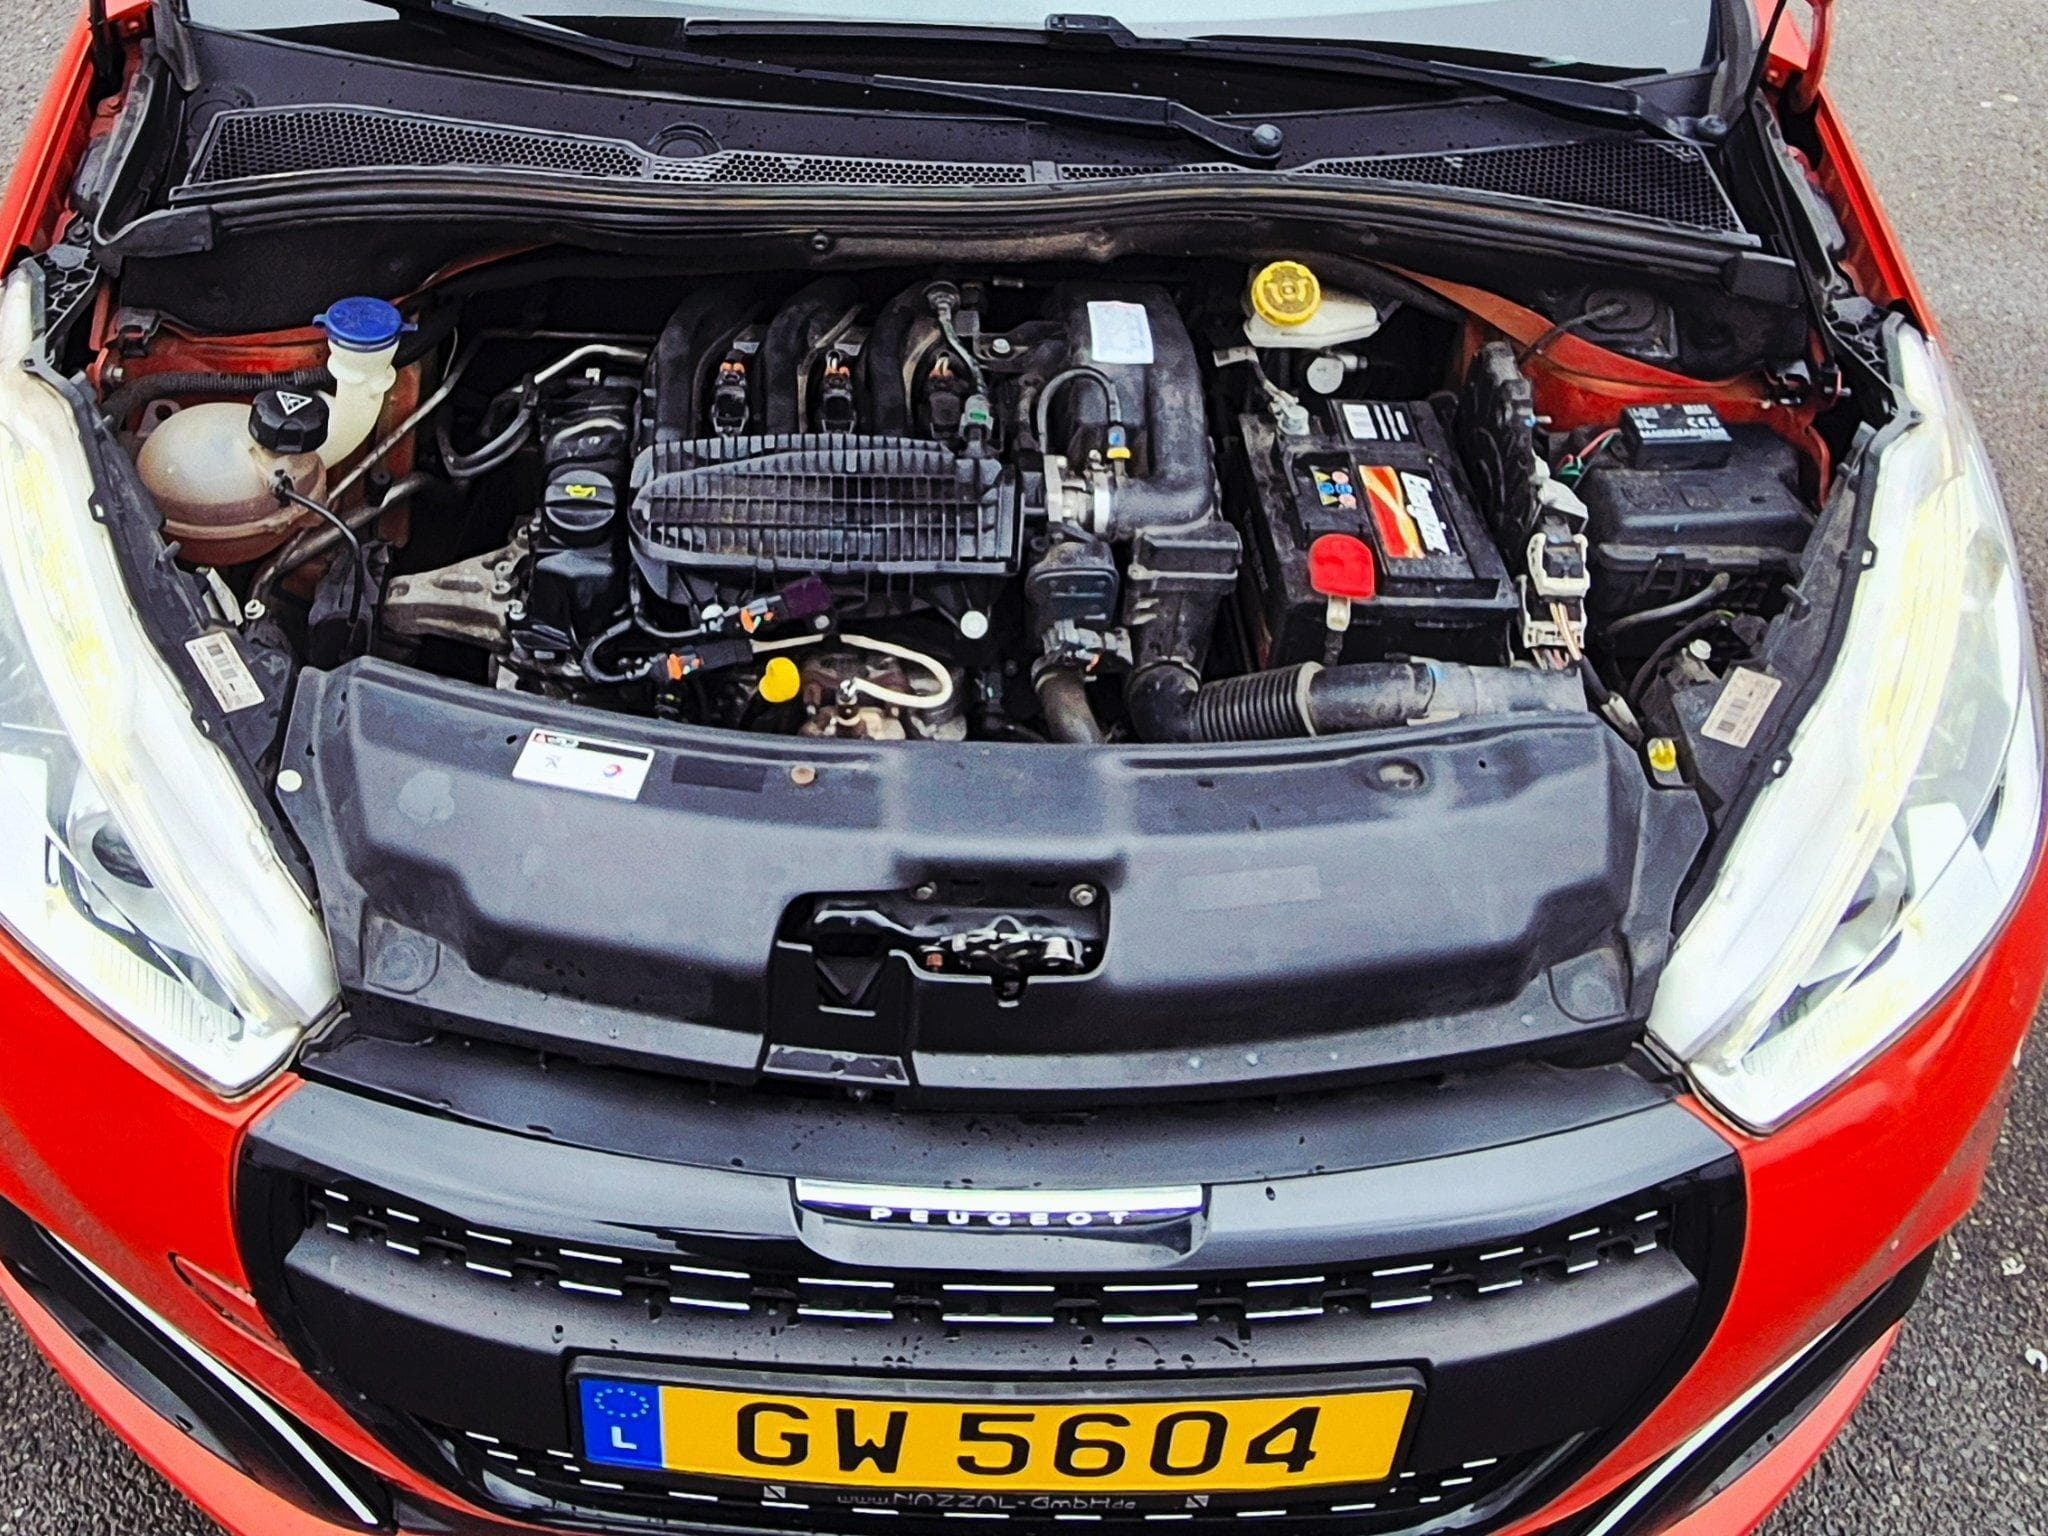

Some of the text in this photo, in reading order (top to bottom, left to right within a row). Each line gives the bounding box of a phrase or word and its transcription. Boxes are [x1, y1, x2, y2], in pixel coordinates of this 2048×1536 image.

[870, 1206, 1131, 1226] PEUGEOT
[611, 1426, 637, 1450] L
[737, 1401, 1321, 1477] GW 5604
